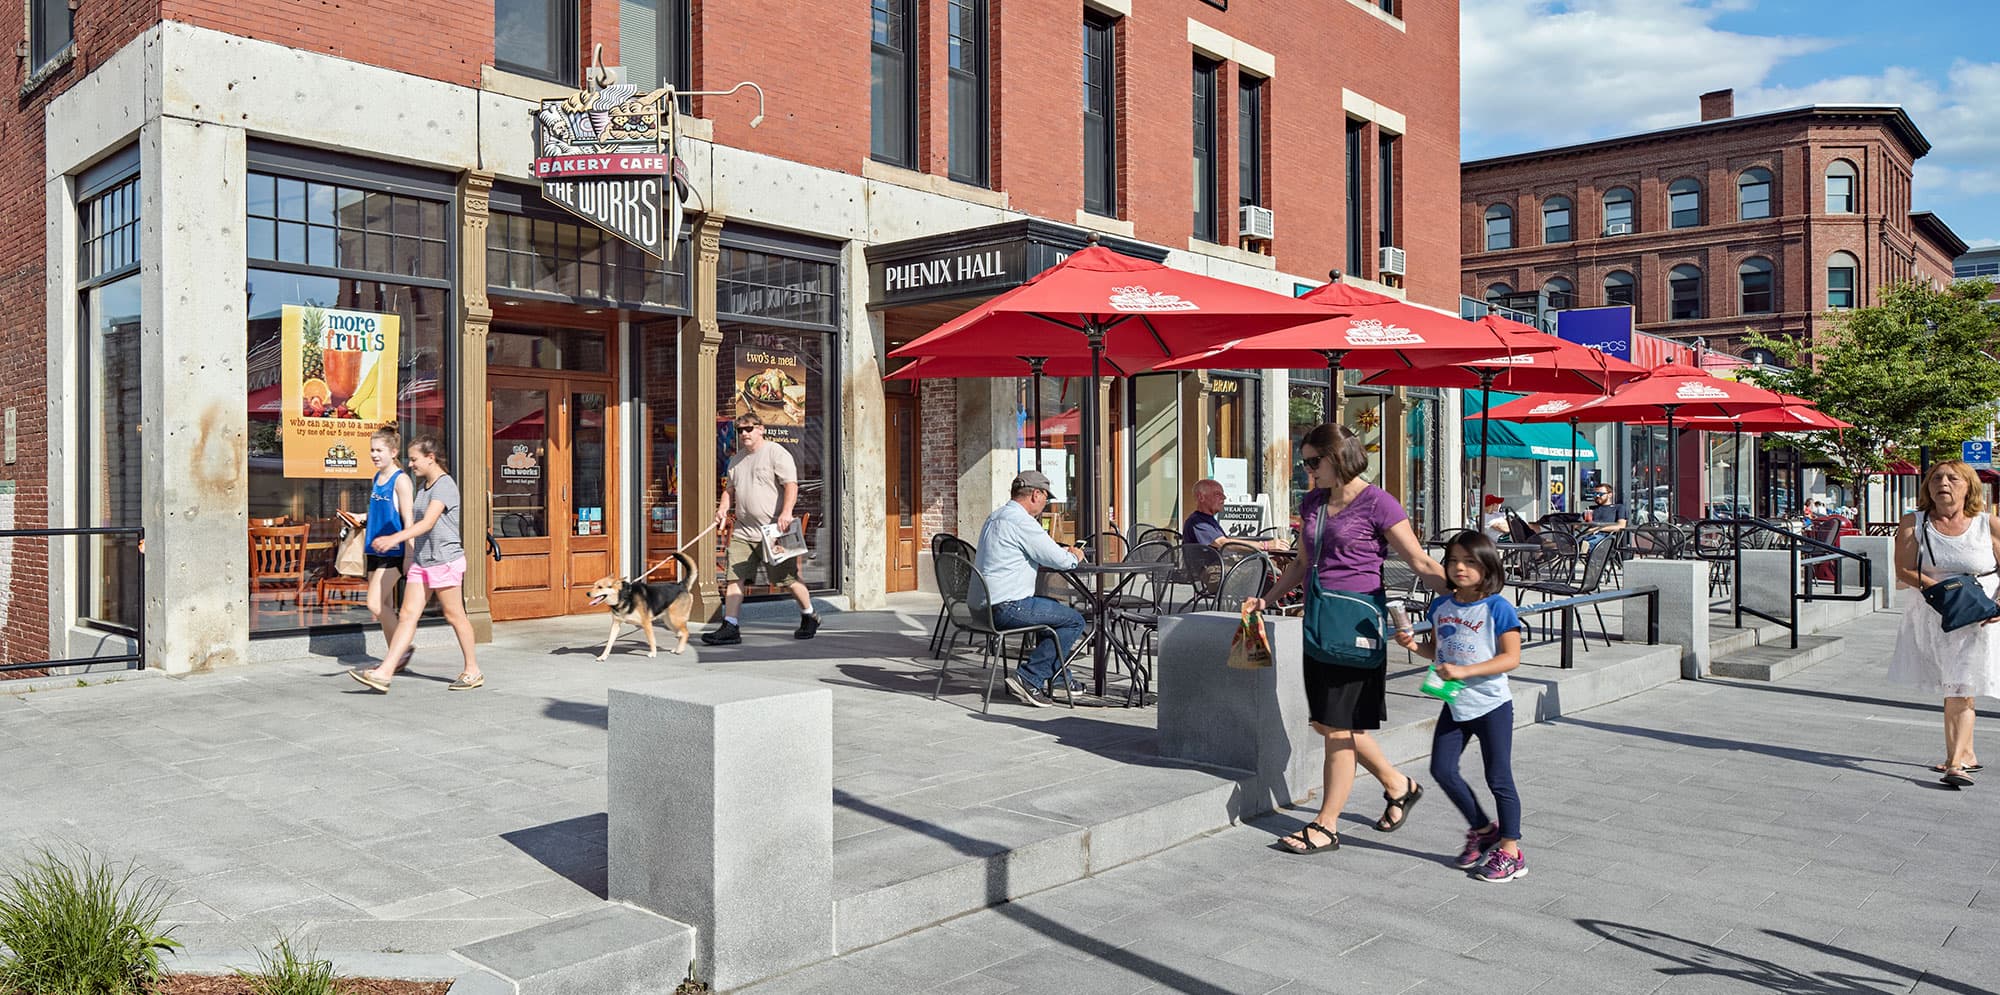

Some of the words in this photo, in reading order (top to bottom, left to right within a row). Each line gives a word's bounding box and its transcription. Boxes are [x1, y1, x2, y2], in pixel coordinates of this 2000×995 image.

[539, 158, 611, 174] BAKERY
[620, 157, 664, 169] CAFE
[546, 182, 575, 207] THE
[578, 179, 657, 246] WORKS
[886, 258, 952, 291] PHENIX
[957, 250, 1006, 281] HALL
[328, 314, 376, 333] more
[325, 329, 385, 352] fruits
[746, 351, 770, 364] two's
[770, 355, 776, 365] a
[777, 355, 797, 366] meal
[1212, 379, 1238, 393] BRAVO
[289, 417, 306, 427] who
[321, 420, 334, 429] say
[337, 420, 346, 428] no
[348, 420, 356, 429] to
[296, 428, 306, 437] try
